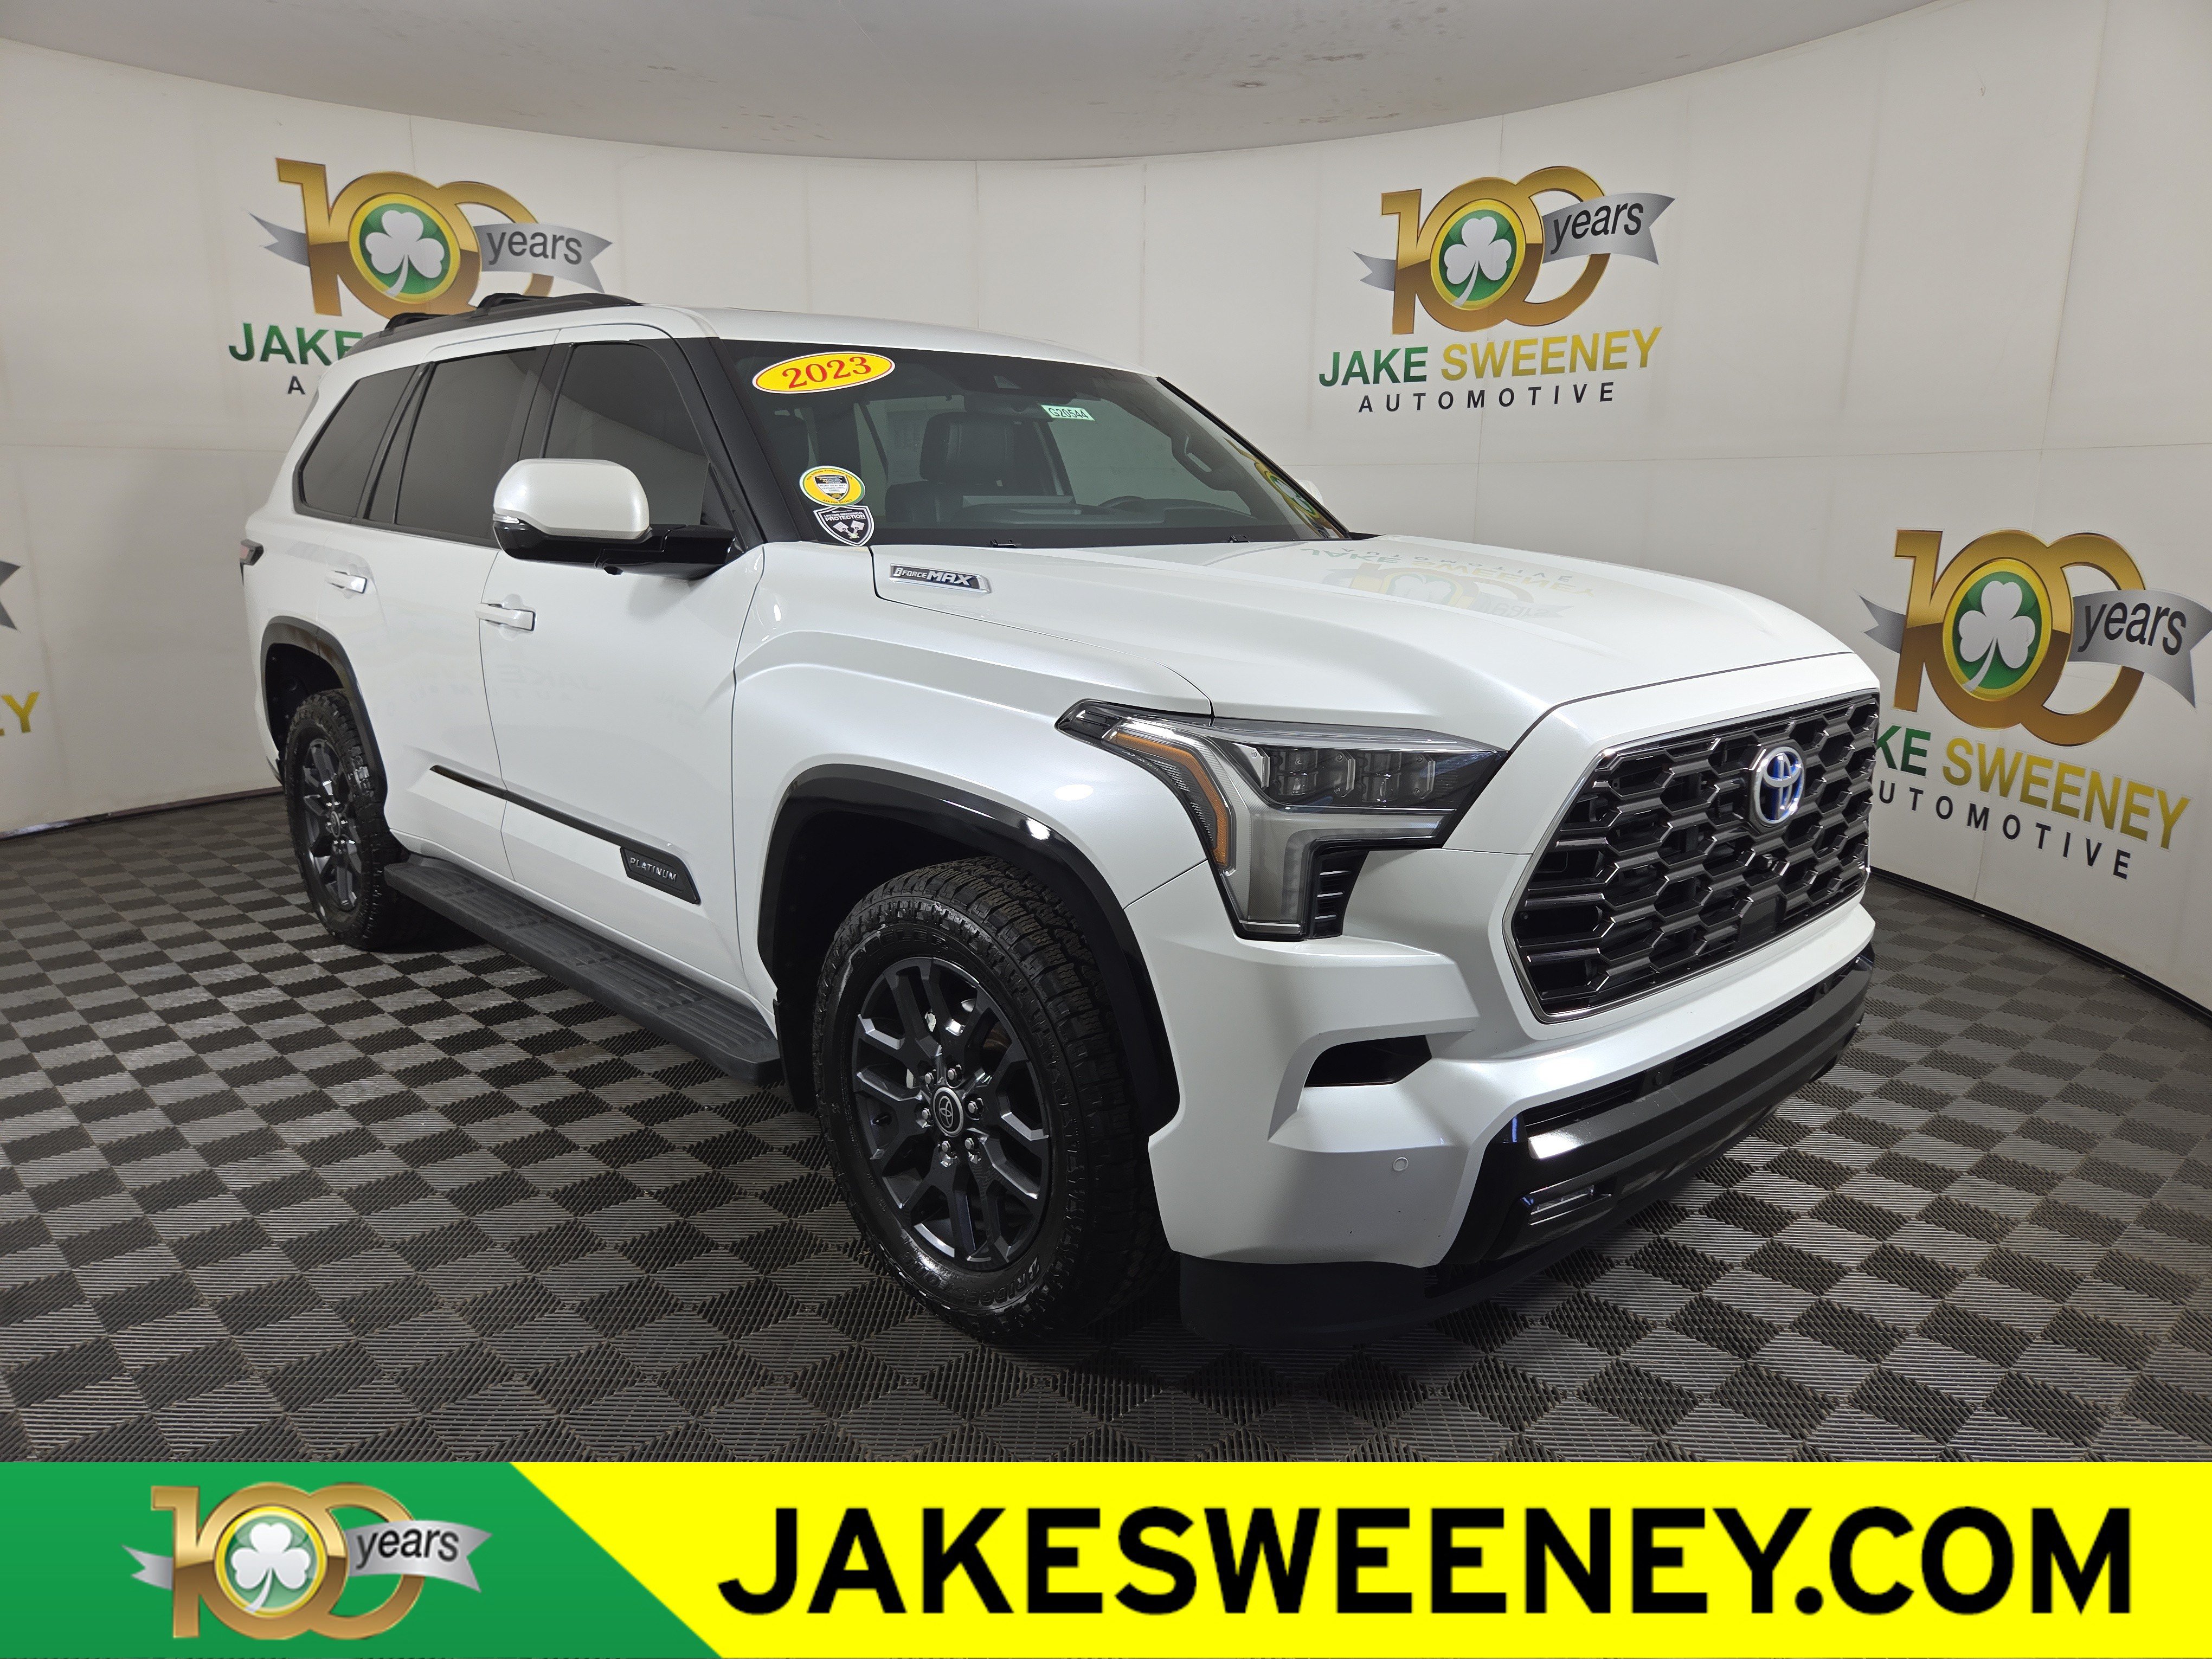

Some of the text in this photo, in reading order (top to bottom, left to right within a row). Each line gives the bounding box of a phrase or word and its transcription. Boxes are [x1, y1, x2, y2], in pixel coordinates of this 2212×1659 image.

[1551, 201, 1644, 255] years
[486, 230, 583, 265] years
[782, 356, 872, 389] 2023
[1319, 327, 1662, 387] JAKE SWEENEY
[1049, 408, 1089, 419] G20544
[1359, 382, 1614, 413] AUTOMOTIVE
[927, 571, 973, 586] MAX
[2078, 602, 2187, 655] years
[1876, 725, 2190, 850] KE SWEENEY
[1880, 780, 2131, 879] UTOMOTIVE
[630, 857, 677, 882] PLATINUM
